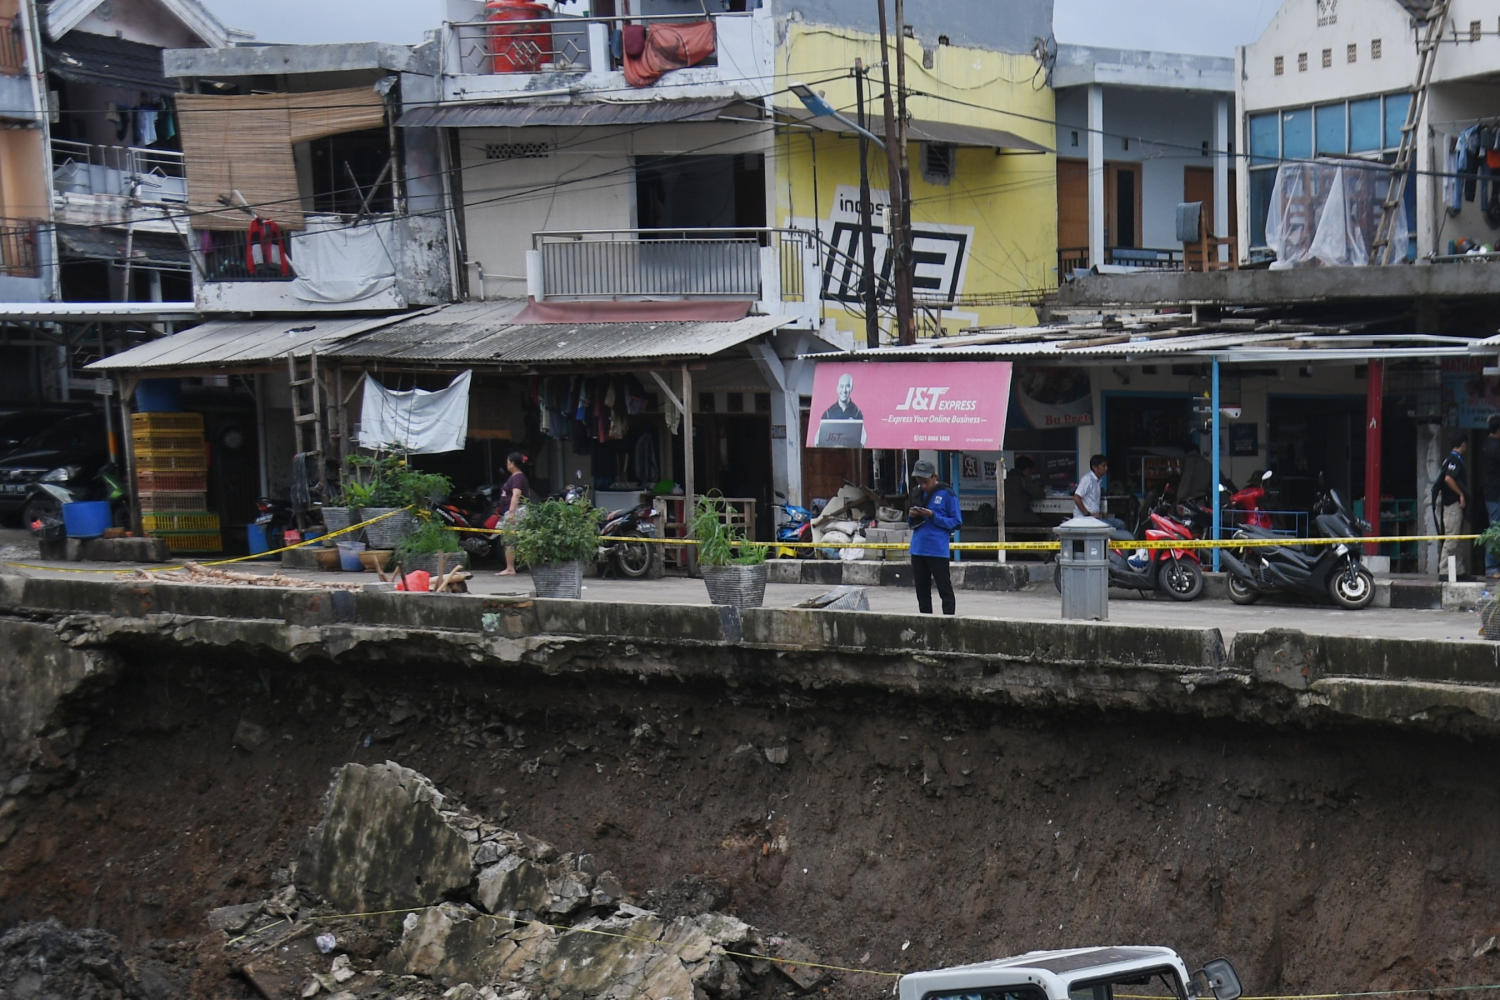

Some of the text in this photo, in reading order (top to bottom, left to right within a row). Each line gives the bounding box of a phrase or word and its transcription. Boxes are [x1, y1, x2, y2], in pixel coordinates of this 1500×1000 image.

[896, 387, 977, 411] J&T EXPRESS
[887, 414, 981, 425] Express Your Online Business
